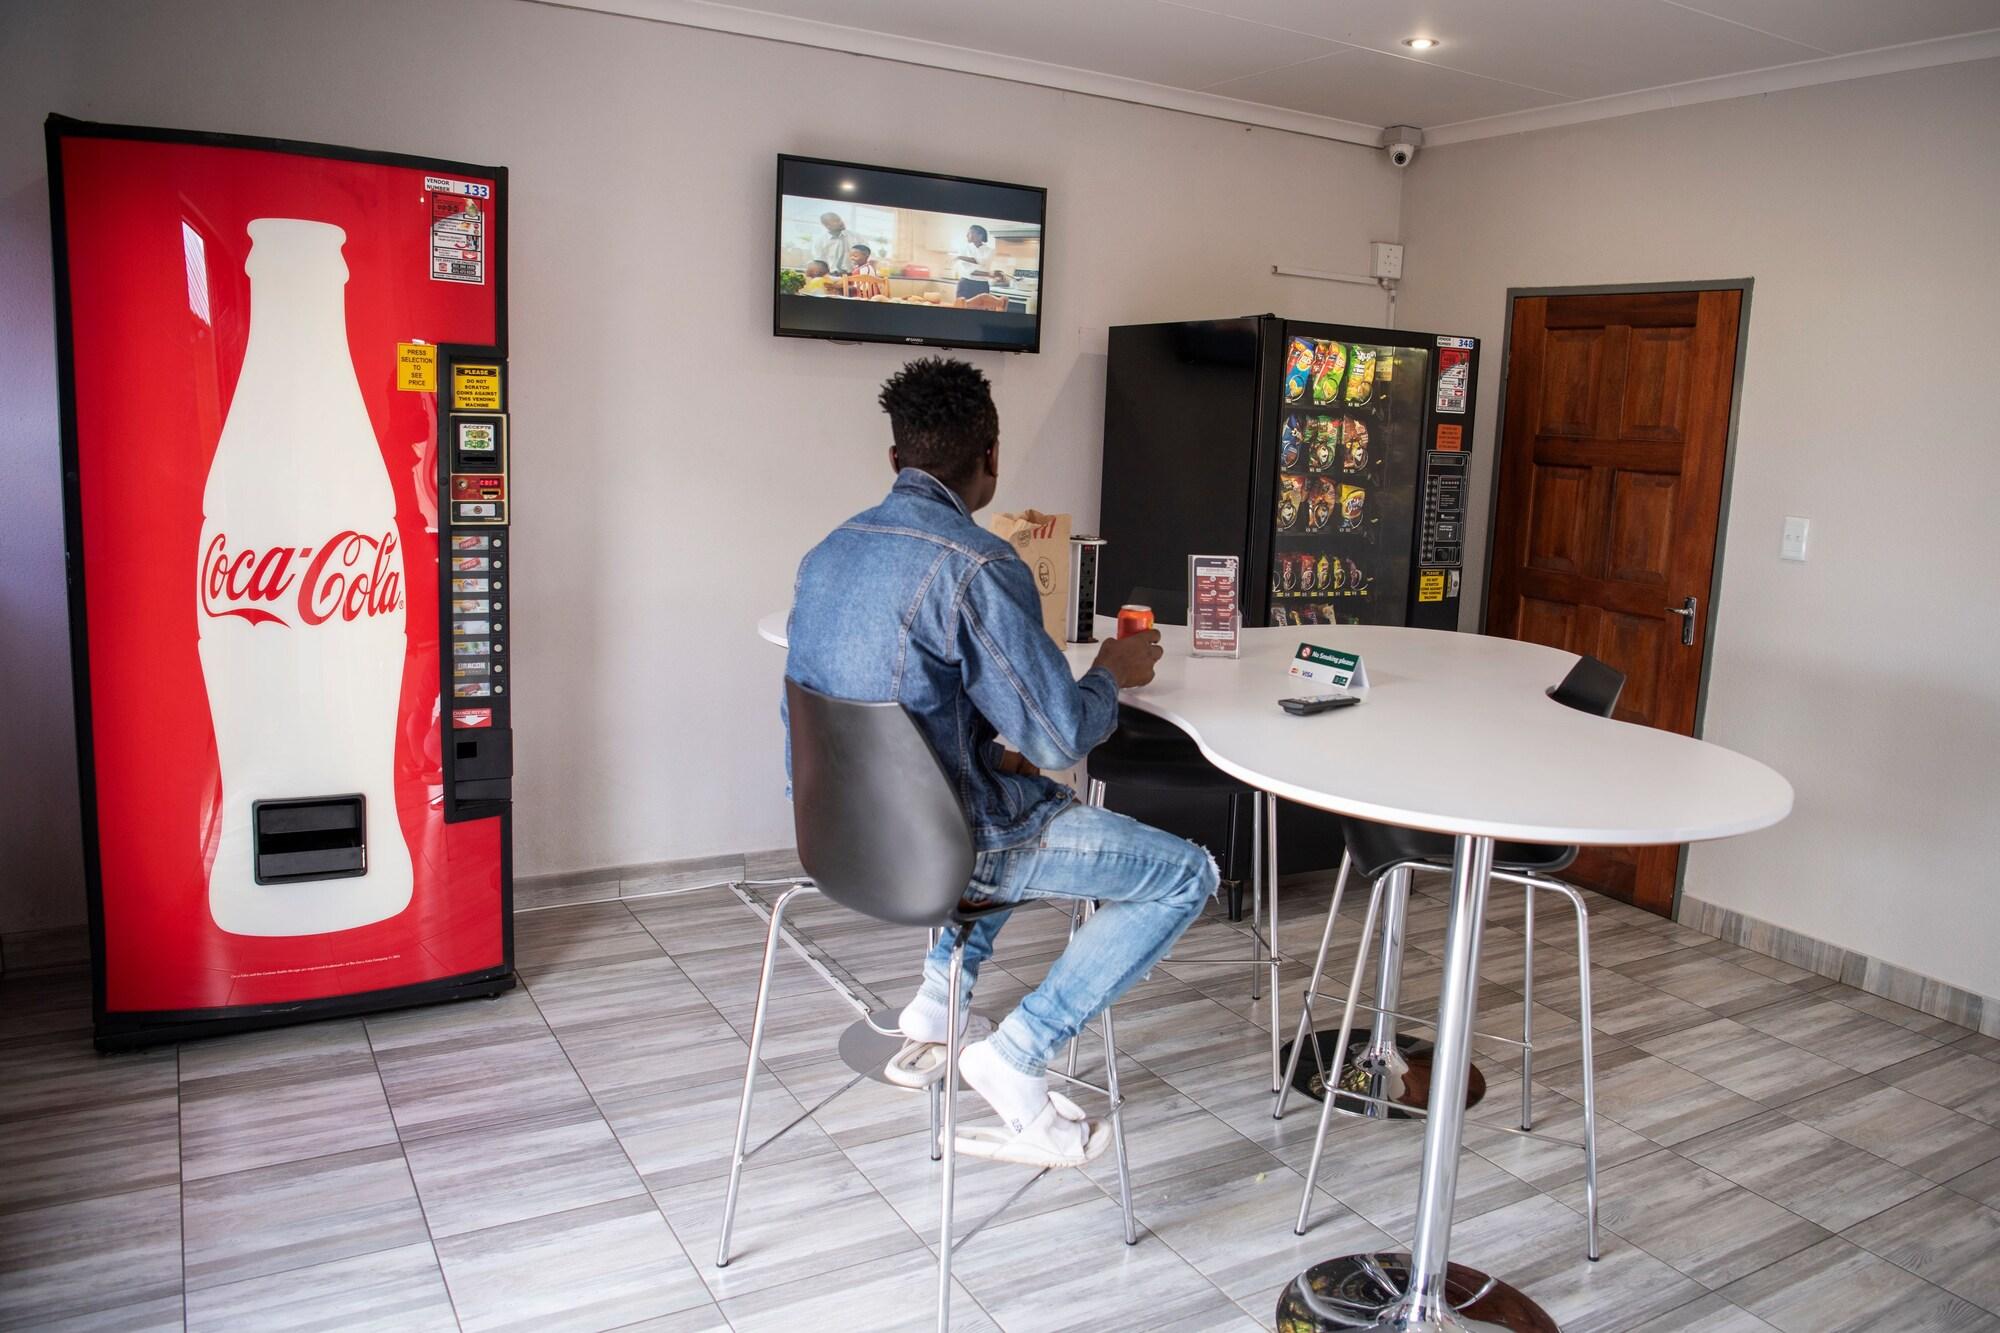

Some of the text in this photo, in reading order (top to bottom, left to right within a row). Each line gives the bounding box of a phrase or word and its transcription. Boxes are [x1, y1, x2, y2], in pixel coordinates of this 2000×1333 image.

[426, 178, 450, 186] VENDOR
[426, 184, 450, 192] NUMBER
[464, 183, 488, 197] 133
[401, 356, 433, 364] SELECTION
[201, 530, 401, 629] Coca-Cola
[1319, 652, 1339, 664] Smoking
[1338, 657, 1355, 666] please
